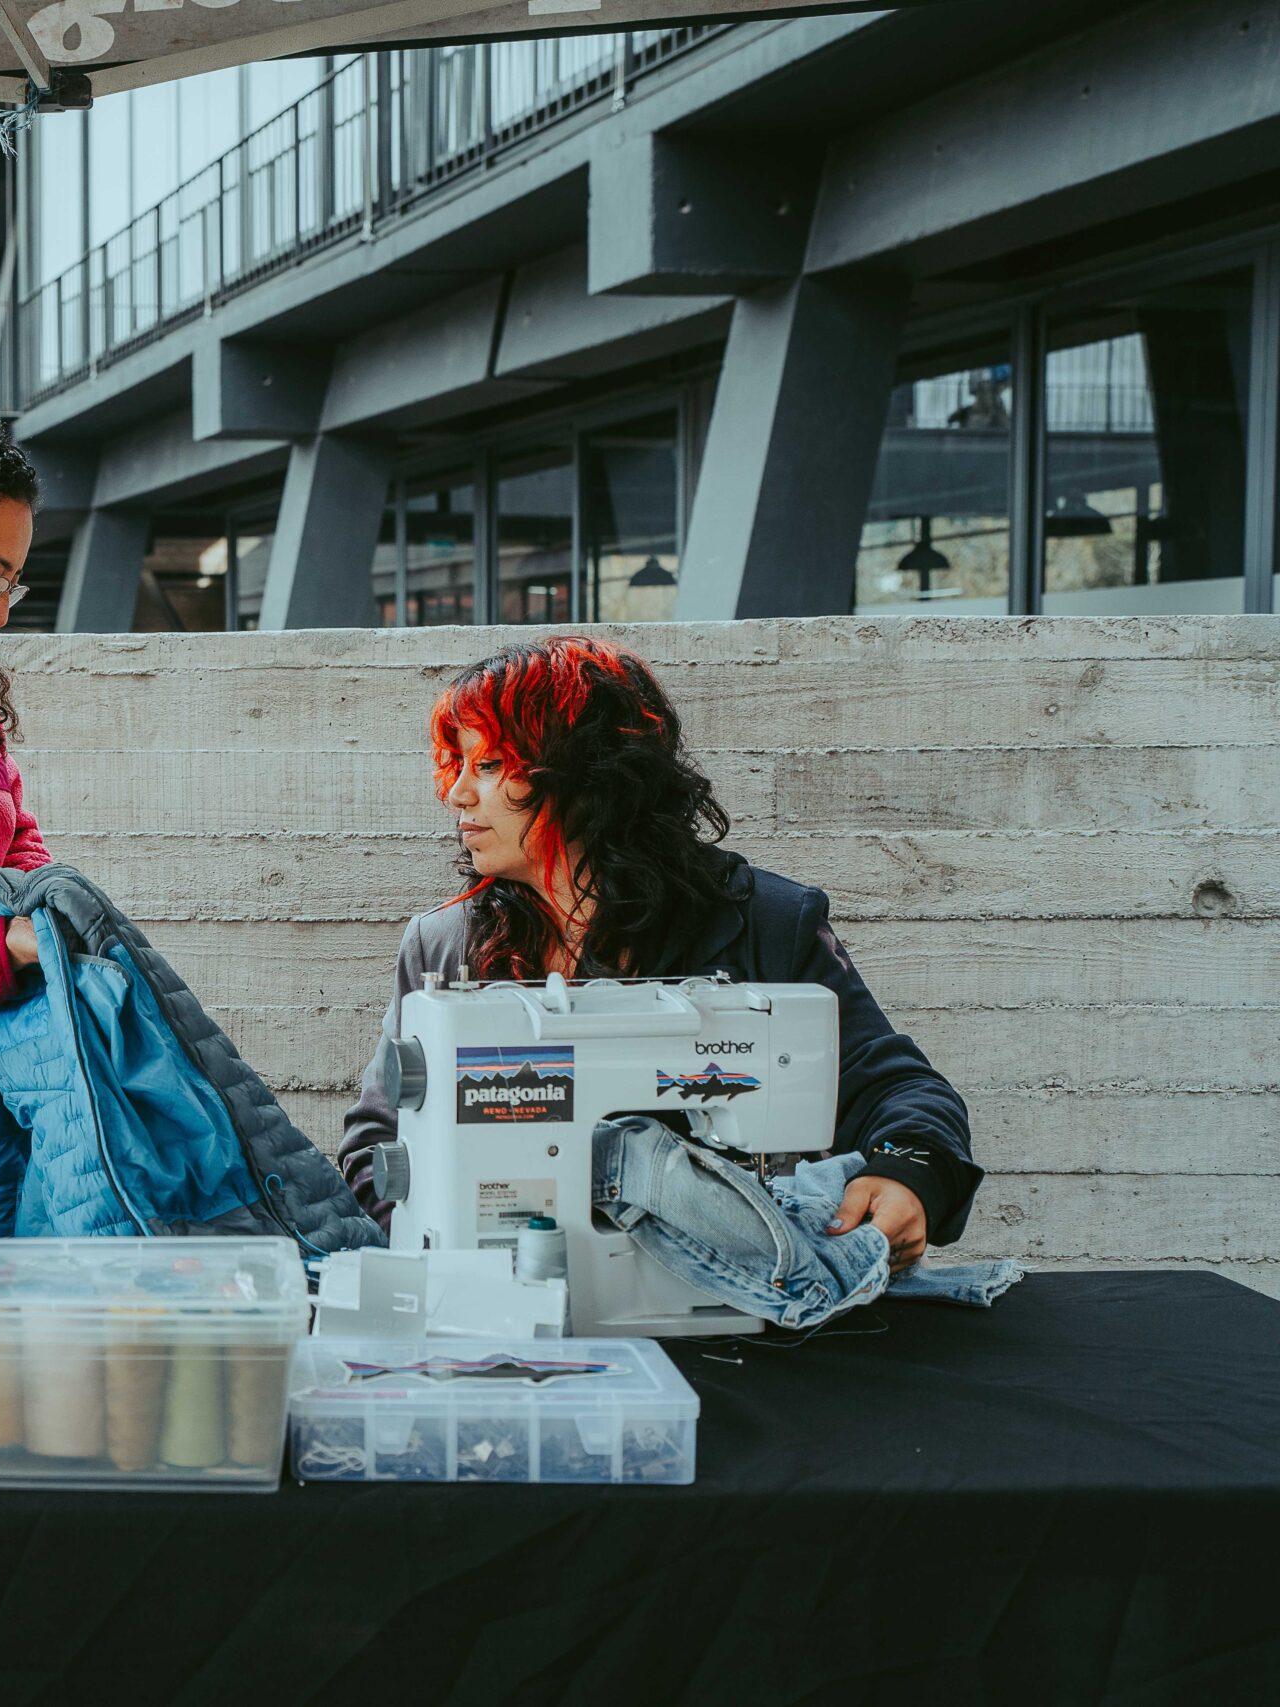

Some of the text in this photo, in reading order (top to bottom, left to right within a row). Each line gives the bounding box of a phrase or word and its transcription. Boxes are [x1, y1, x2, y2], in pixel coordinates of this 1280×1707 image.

[695, 1040, 755, 1055] brother
[464, 1083, 566, 1106] patagonia
[483, 1106, 548, 1115] RENO NEVADA
